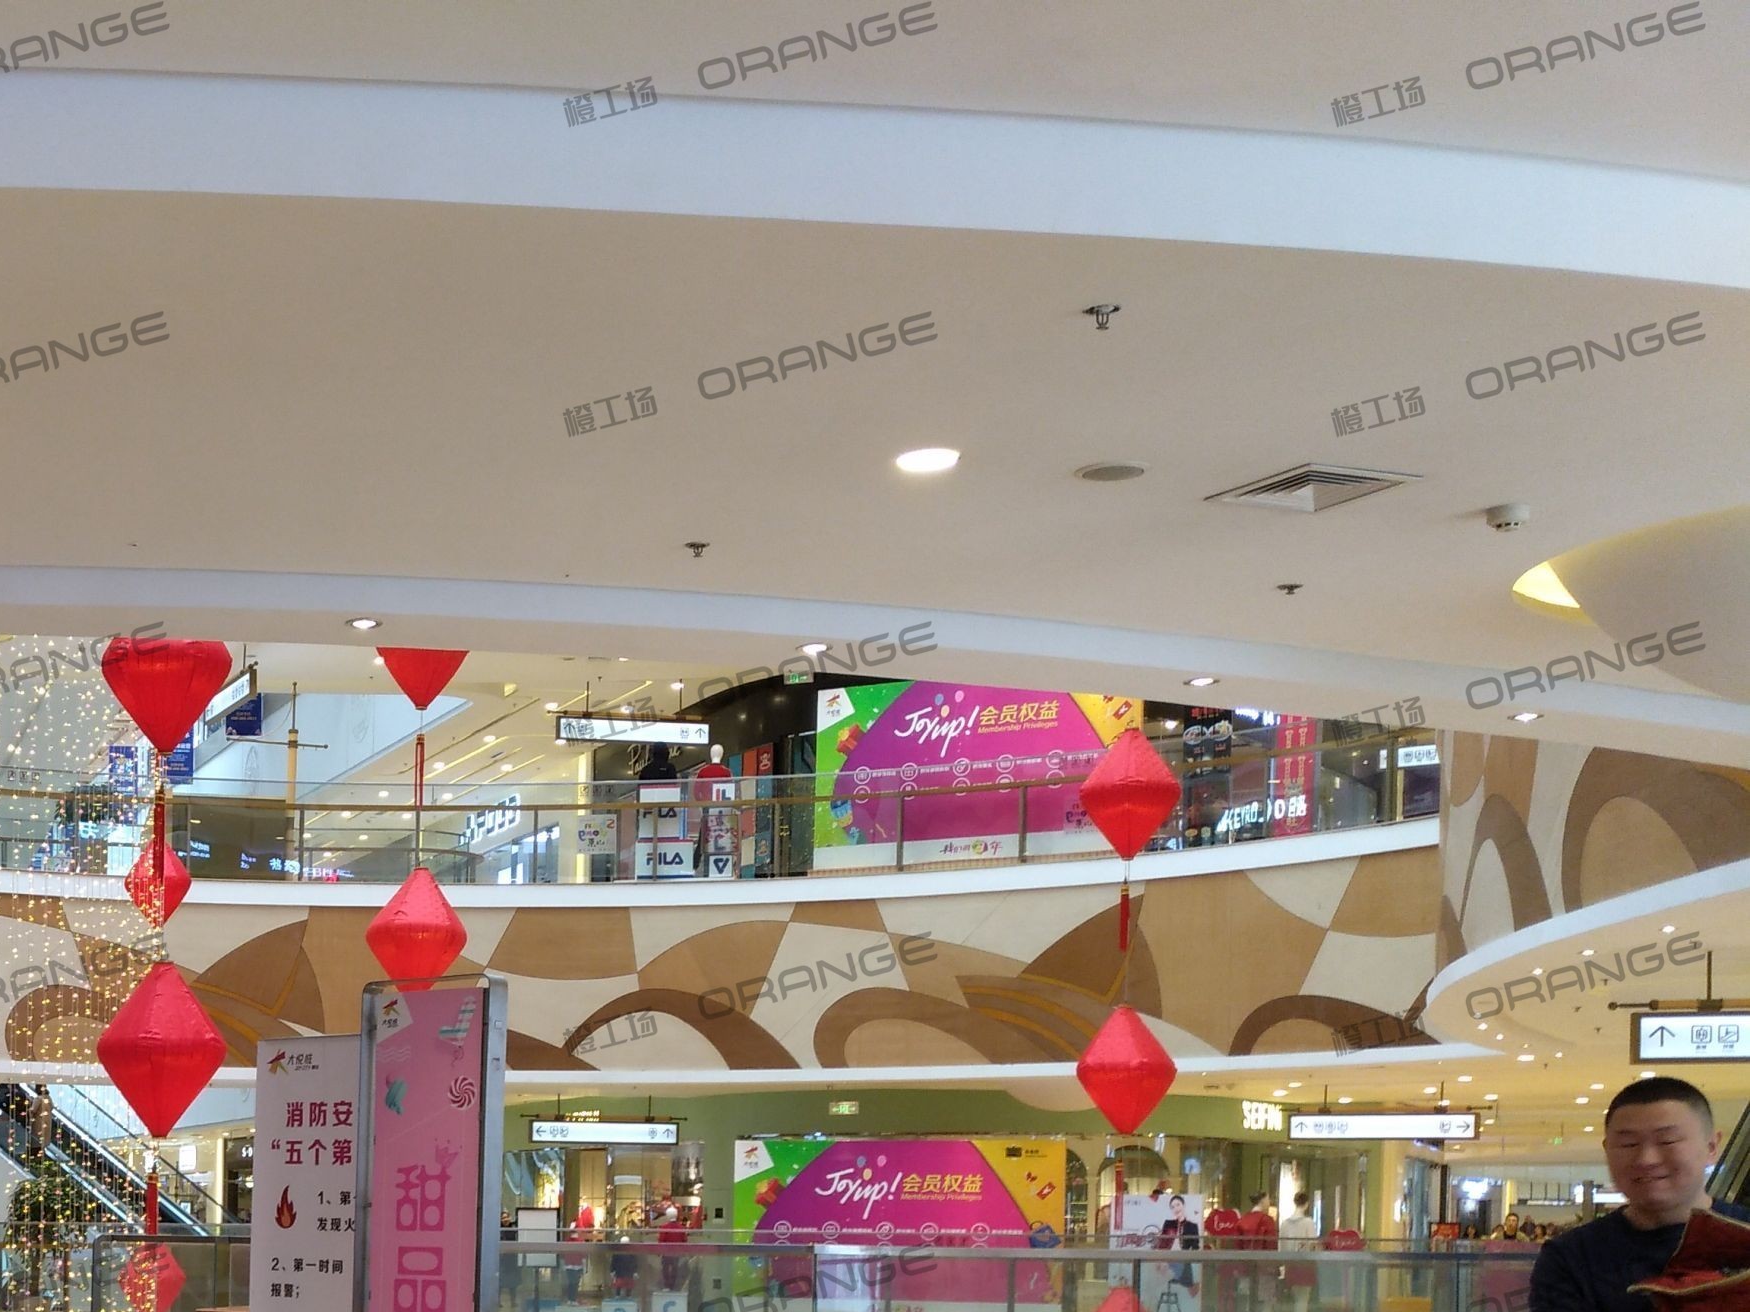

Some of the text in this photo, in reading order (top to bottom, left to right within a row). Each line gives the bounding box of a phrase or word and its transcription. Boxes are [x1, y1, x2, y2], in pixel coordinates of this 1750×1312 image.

[979, 700, 1060, 725] 会员权益
[643, 807, 677, 818] FLA
[646, 852, 684, 865] FILA
[286, 1101, 353, 1128] 消防安
[902, 1174, 983, 1194] 会员权益
[317, 1190, 356, 1206] 1、第
[271, 1257, 344, 1275] 2、第一时间
